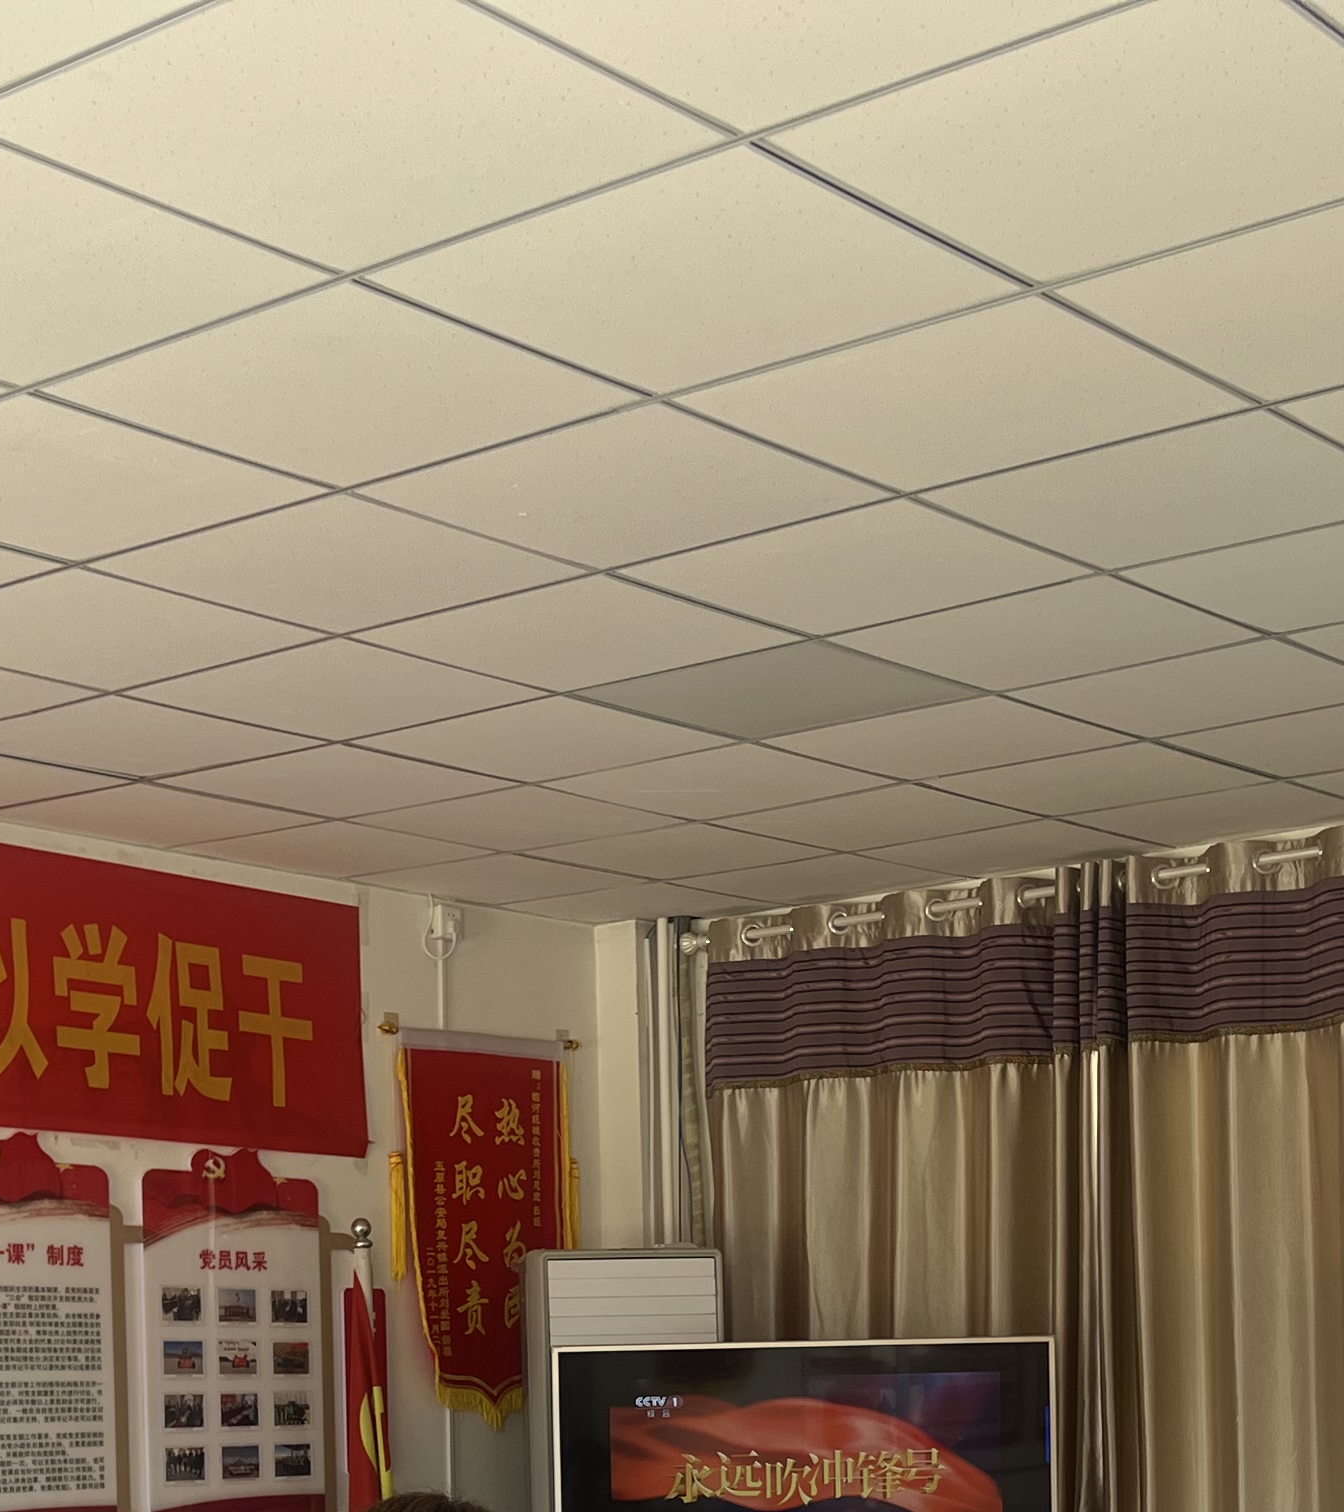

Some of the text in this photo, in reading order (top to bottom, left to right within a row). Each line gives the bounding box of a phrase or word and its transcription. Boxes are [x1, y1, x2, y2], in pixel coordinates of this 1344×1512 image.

[449, 1094, 490, 1336] 尽职尽责
[199, 1249, 268, 1272] 党员风采
[664, 1446, 946, 1505] 永远吹冲锋号
